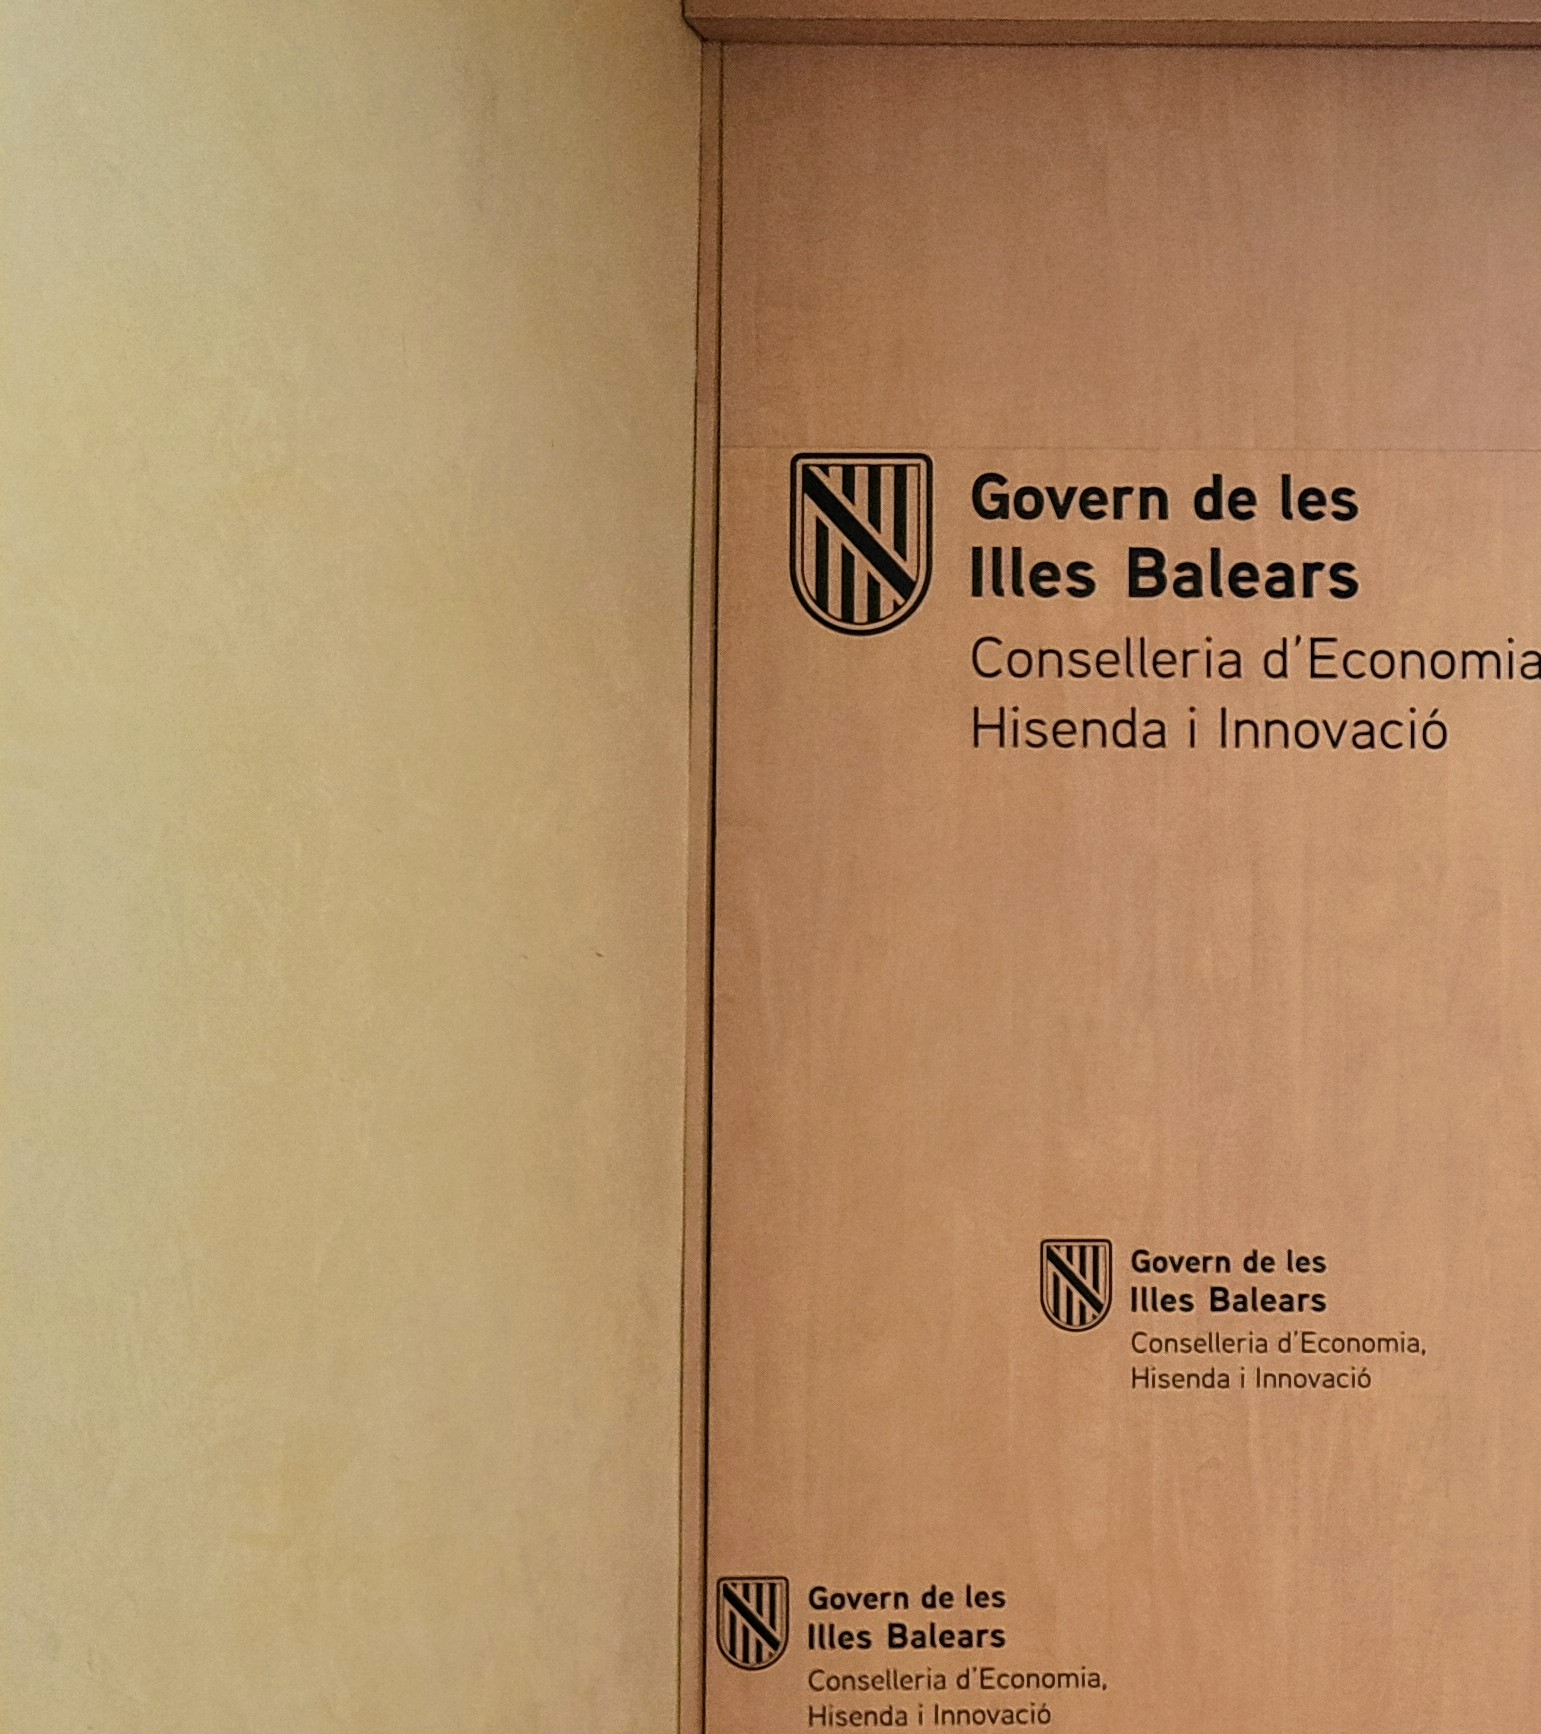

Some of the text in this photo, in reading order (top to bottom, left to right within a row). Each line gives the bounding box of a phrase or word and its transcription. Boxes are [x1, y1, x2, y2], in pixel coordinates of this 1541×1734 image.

[971, 472, 1359, 522] Govern de les
[970, 545, 1359, 600] Illes Balears
[971, 635, 1242, 682] Conselleria
[972, 705, 1448, 750] Hisenda i Innovació
[1130, 1248, 1327, 1274] Govern de les
[1130, 1285, 1327, 1313] Illes Balears
[1131, 1329, 1426, 1358] Conselleria d’Economia,
[1131, 1365, 1372, 1390] Hisenda i Innovació
[808, 1583, 1006, 1611] Govern de les
[807, 1621, 1006, 1651] Illes Balears
[807, 1665, 1108, 1693] Conselleria d’Economia,
[808, 1701, 1052, 1728] Hisenda i Innovació
